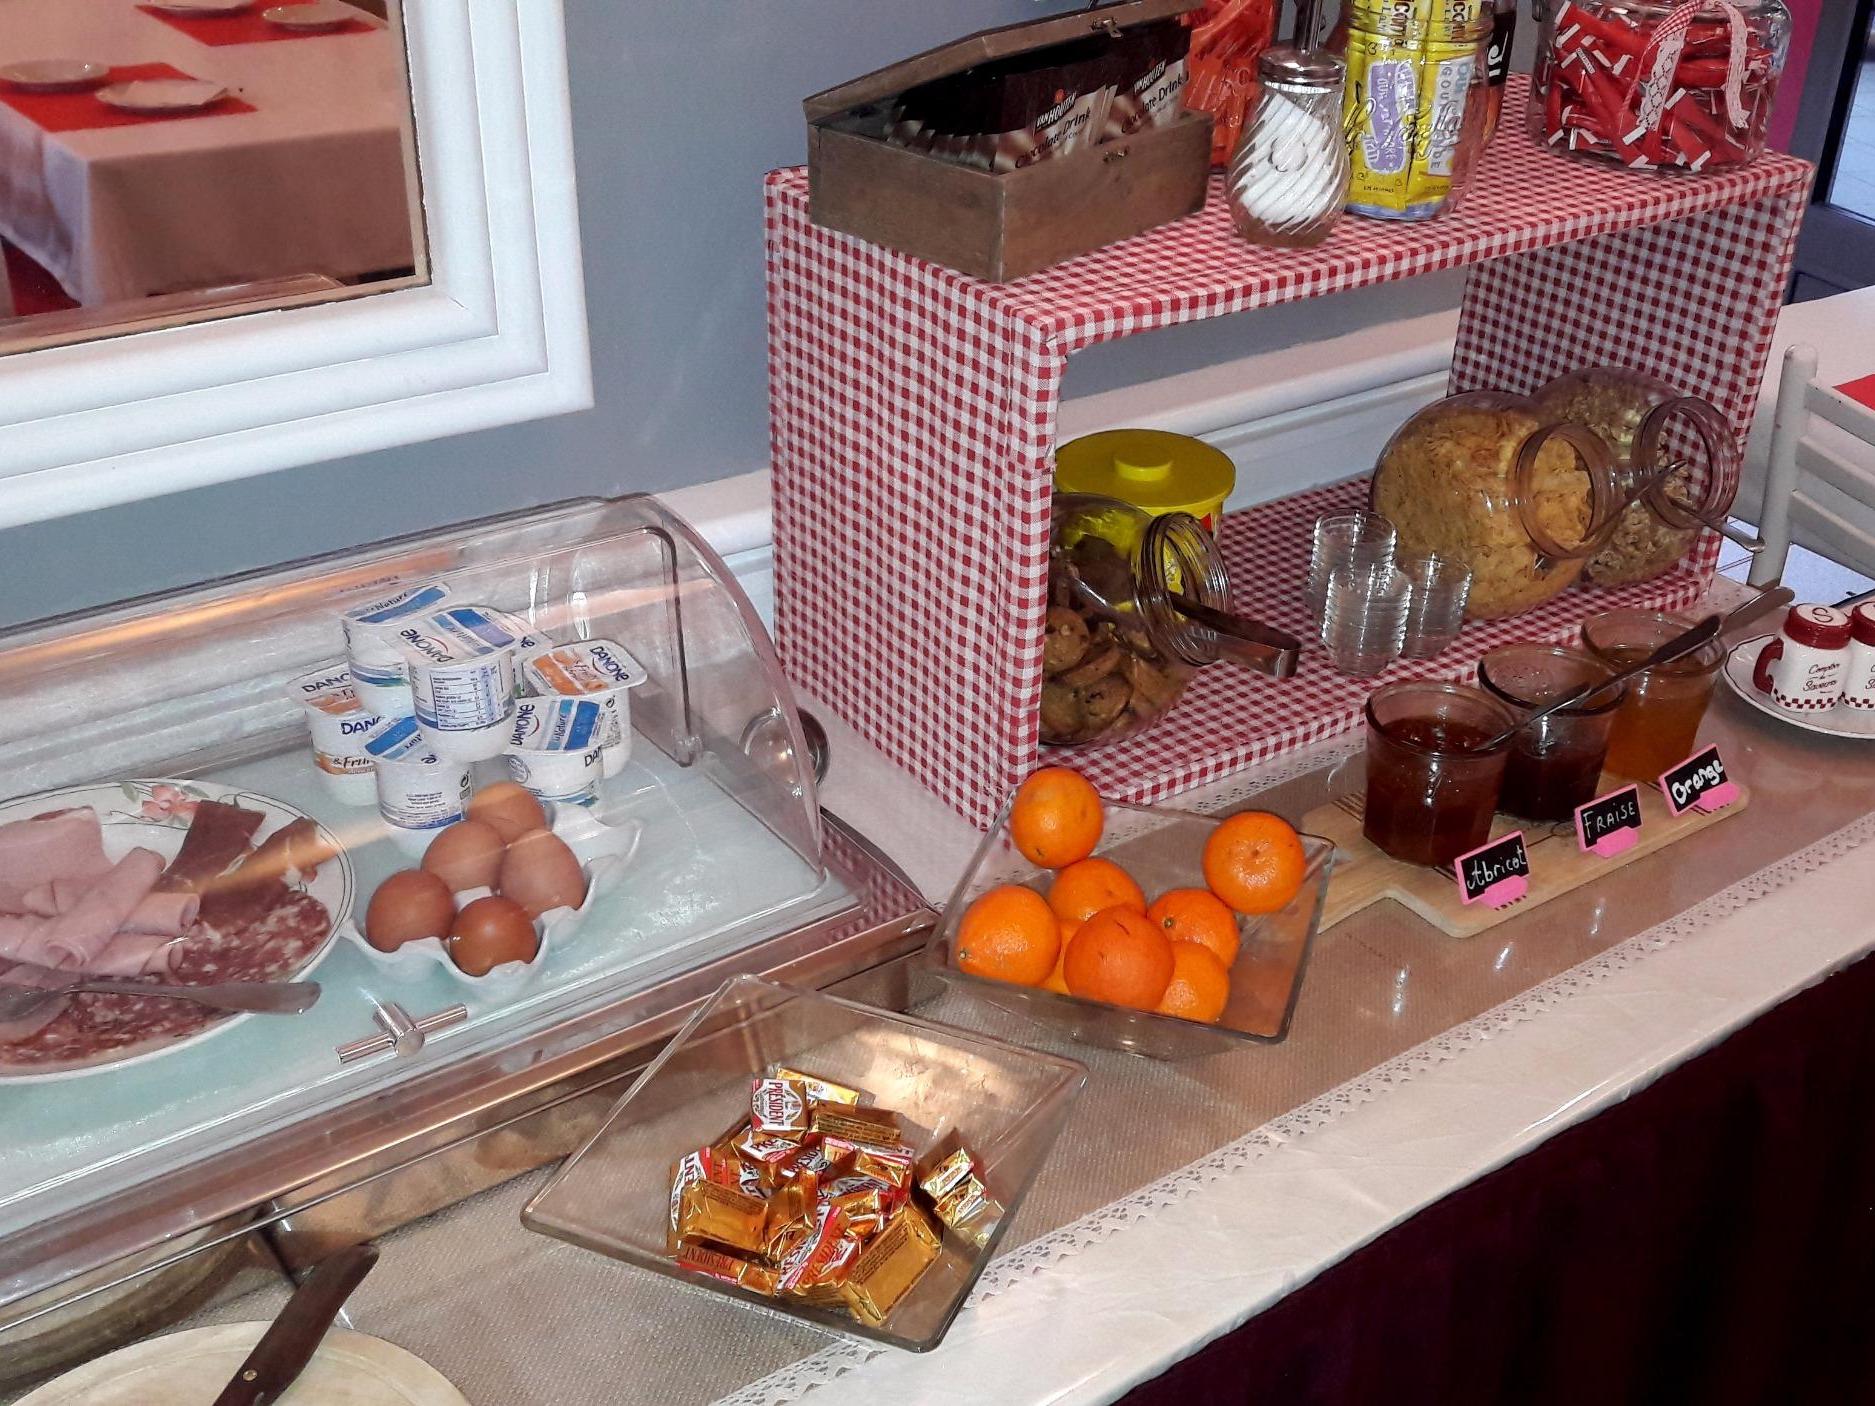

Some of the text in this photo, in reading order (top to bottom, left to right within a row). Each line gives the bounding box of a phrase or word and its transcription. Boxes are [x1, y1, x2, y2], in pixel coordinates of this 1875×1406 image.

[1062, 107, 1091, 136] Drink
[401, 628, 455, 663] DANONE
[589, 645, 630, 682] DANONE
[1671, 760, 1724, 805] Orange
